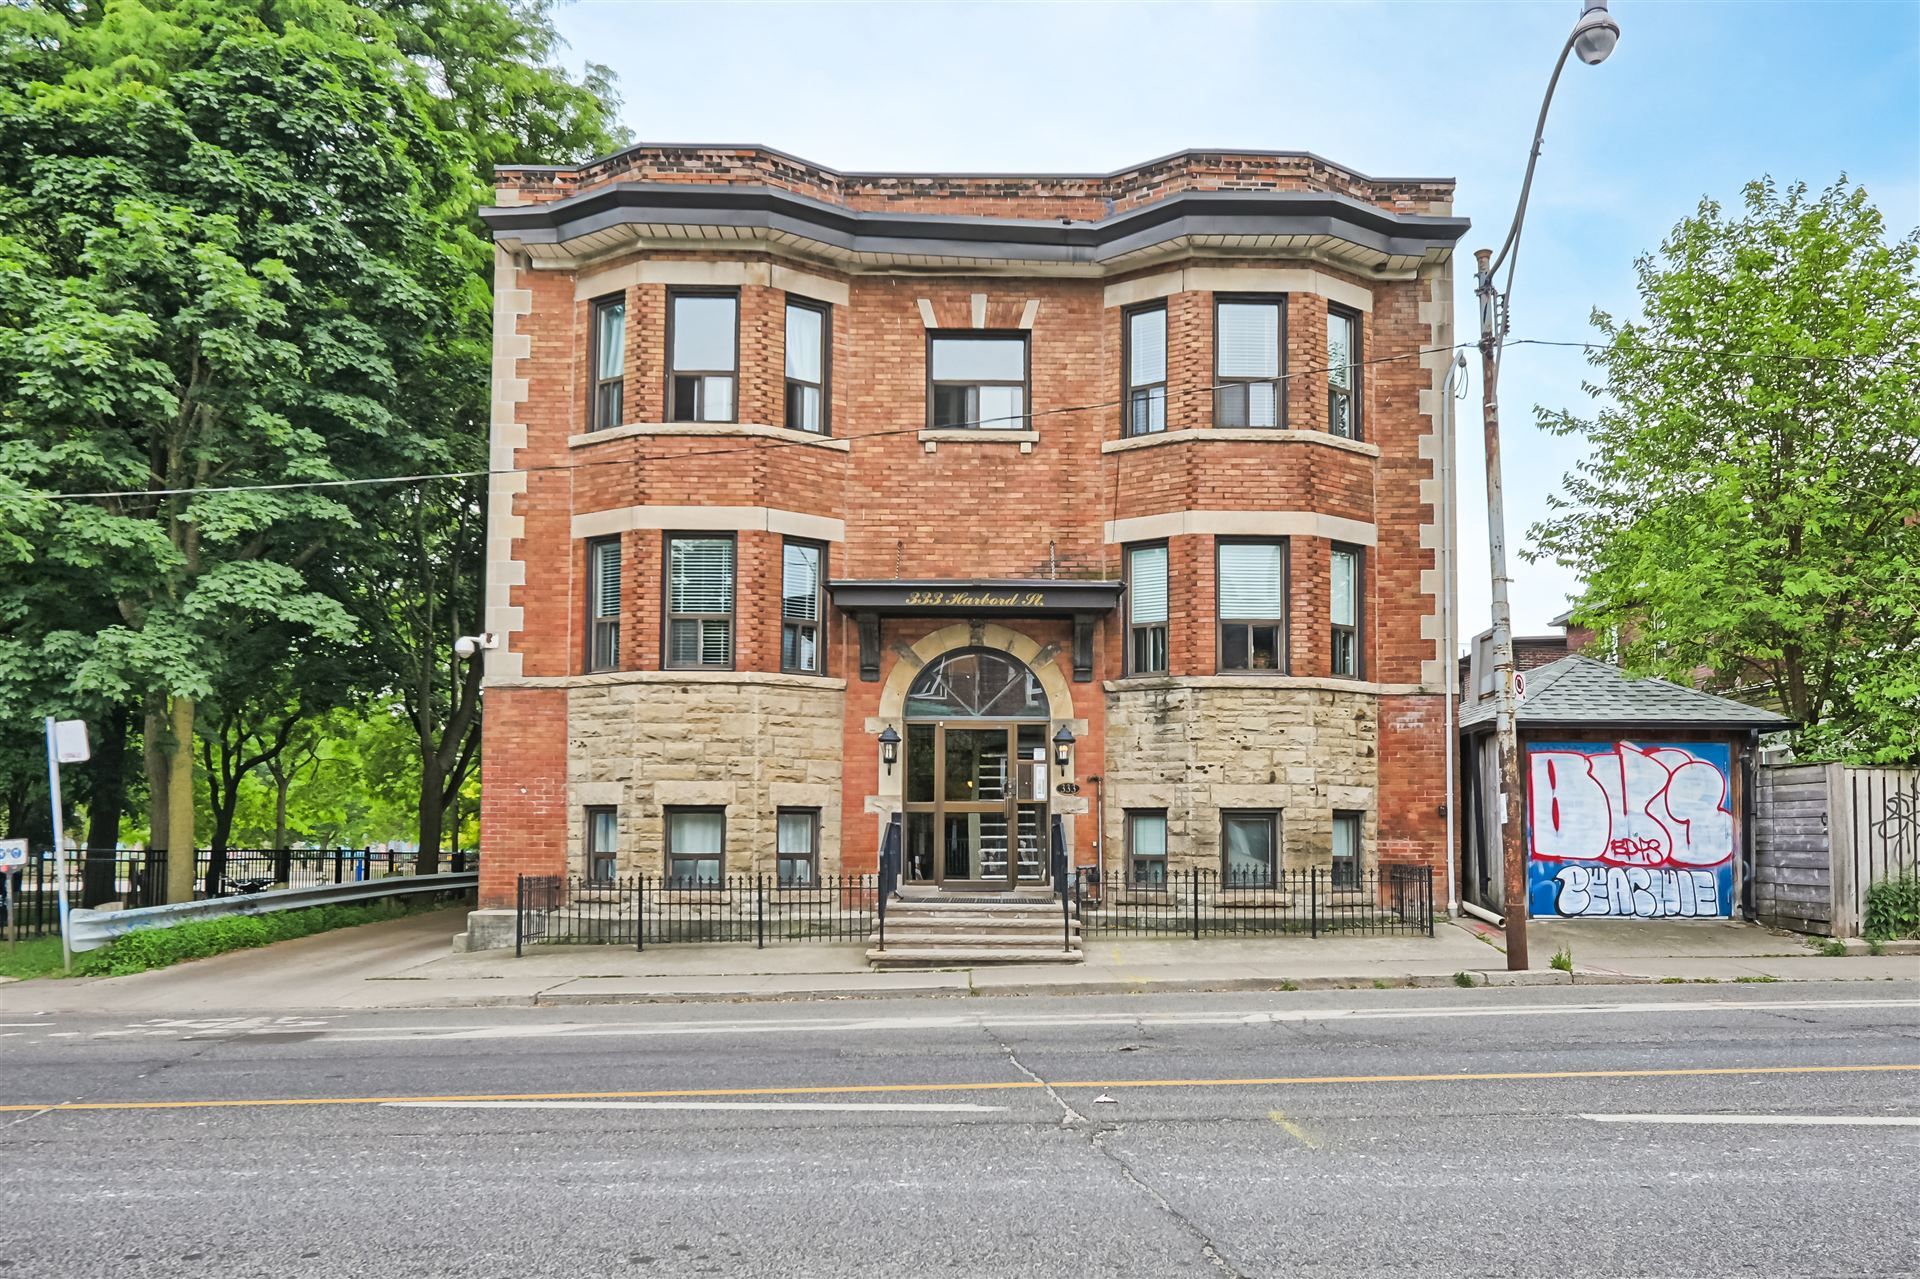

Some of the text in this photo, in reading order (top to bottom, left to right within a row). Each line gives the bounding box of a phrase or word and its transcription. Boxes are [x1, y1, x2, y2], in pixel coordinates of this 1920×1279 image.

[905, 591, 1044, 606] 333 Harbord St.
[1060, 784, 1077, 793] 333
